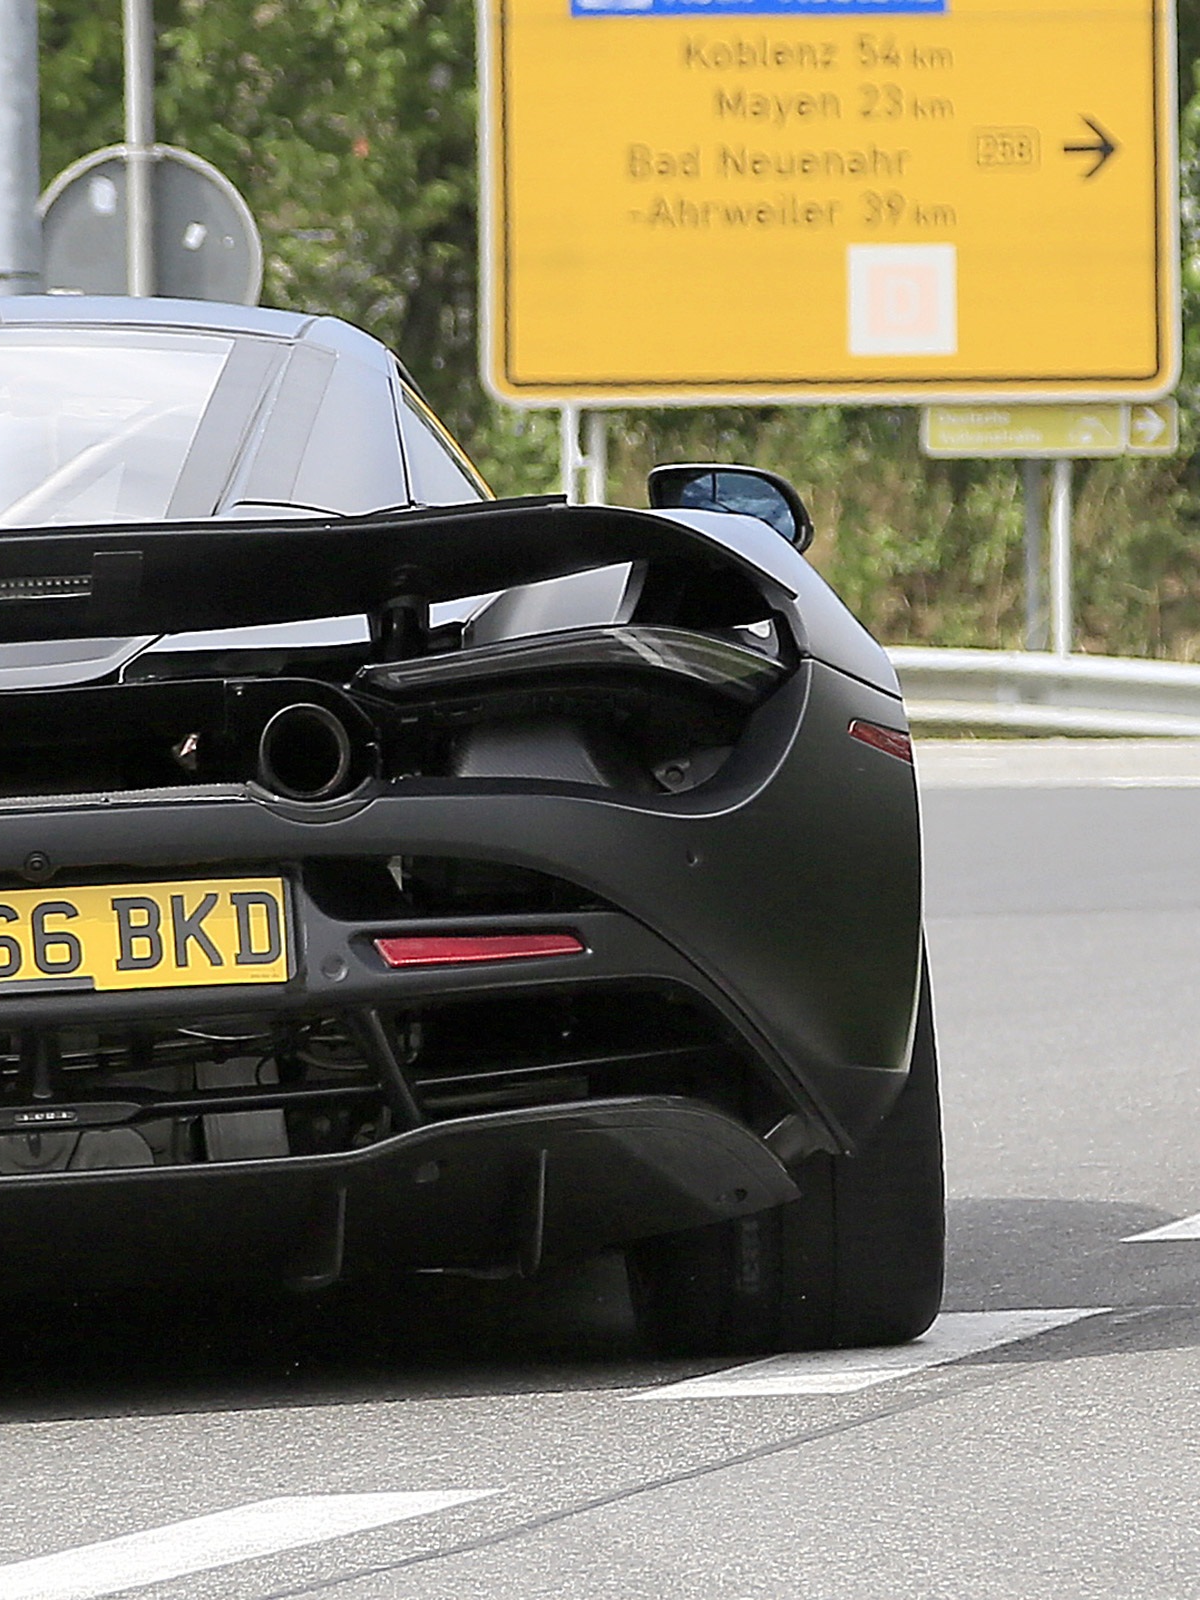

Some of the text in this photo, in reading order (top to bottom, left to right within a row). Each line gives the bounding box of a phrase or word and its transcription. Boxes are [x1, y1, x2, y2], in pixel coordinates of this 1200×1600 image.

[678, 32, 954, 69] Koblenz 54 km
[712, 82, 955, 127] Mayen 23 km
[626, 141, 912, 179] Bad Neuenahr
[860, 189, 907, 228] 39
[914, 200, 957, 227] km
[111, 891, 283, 972] BKD
